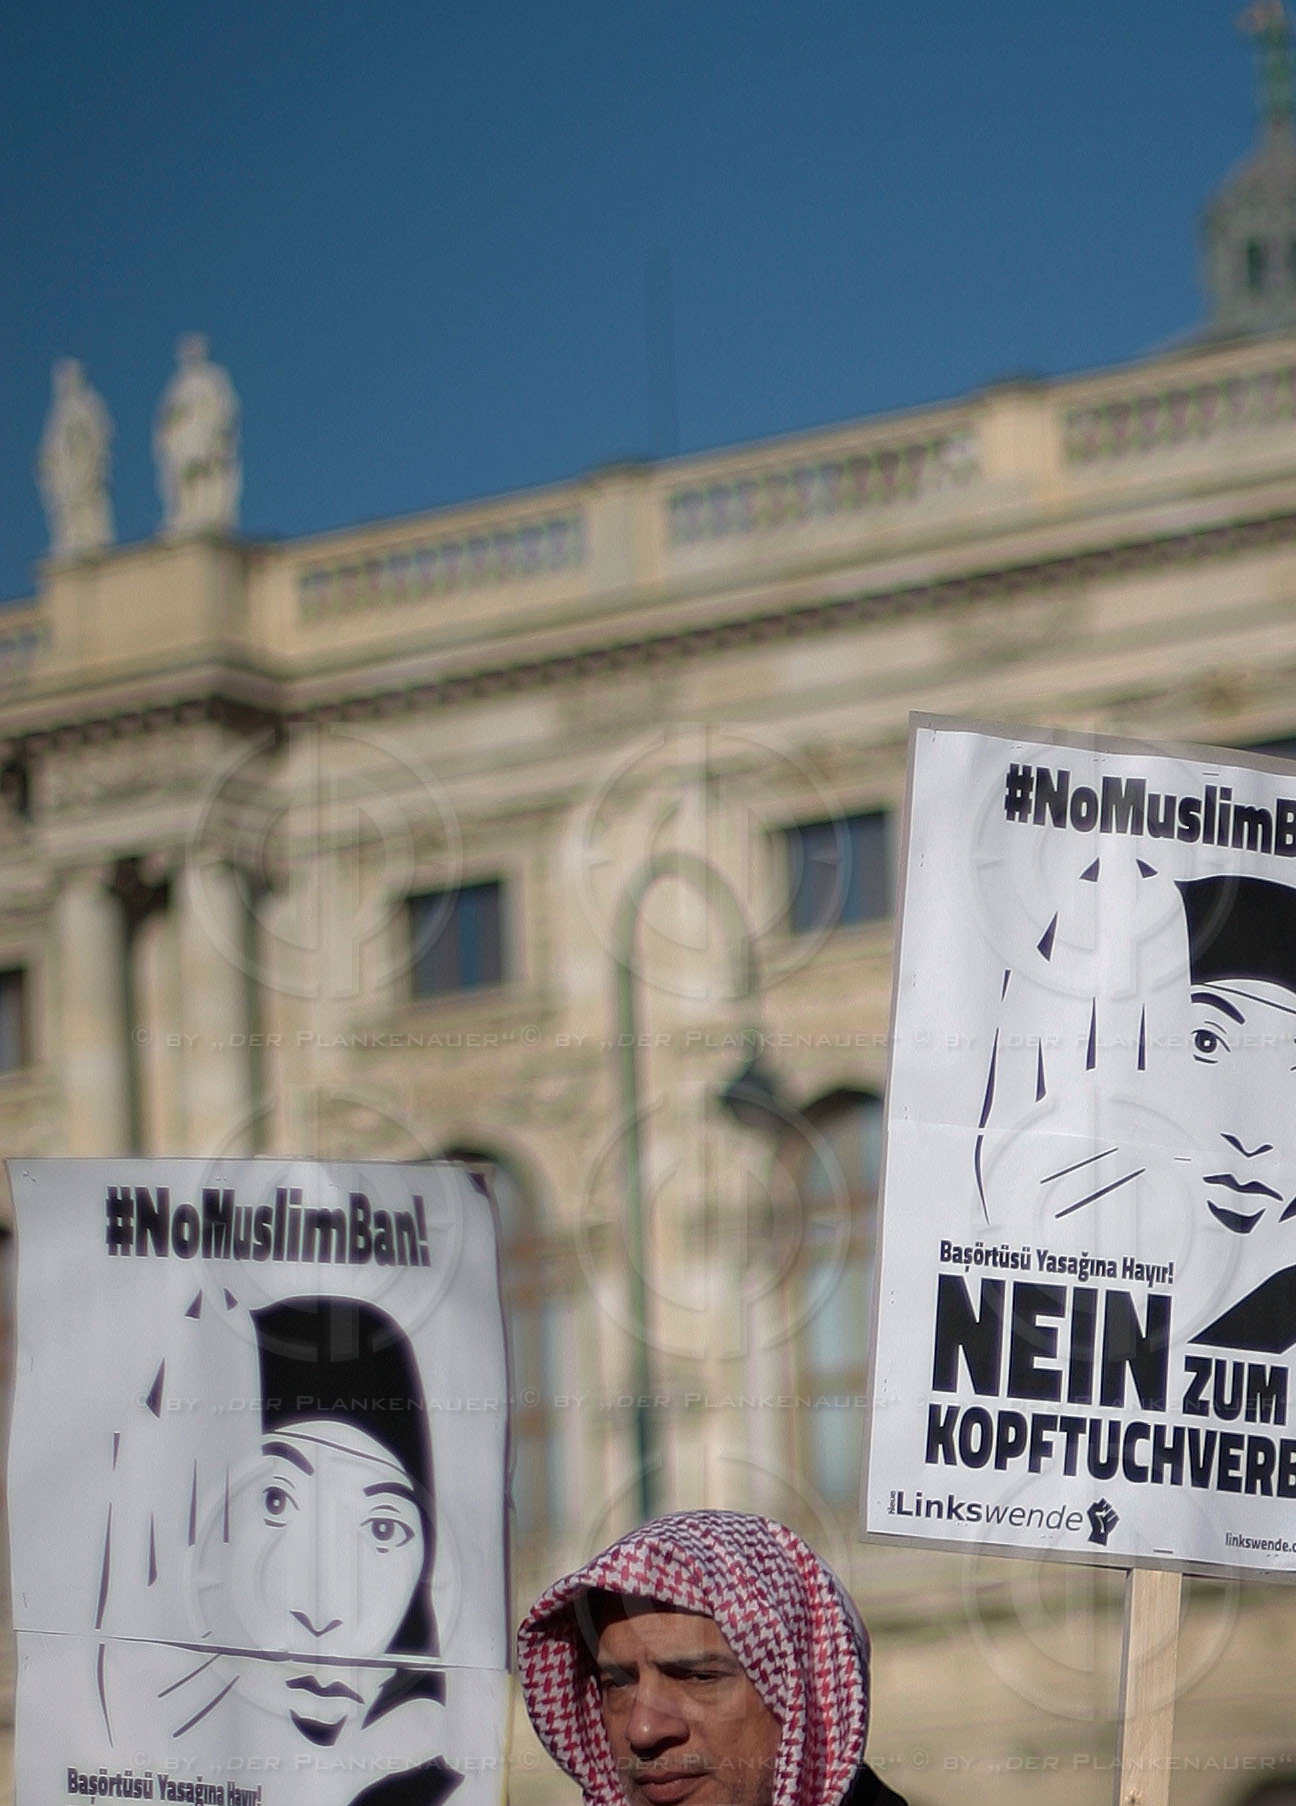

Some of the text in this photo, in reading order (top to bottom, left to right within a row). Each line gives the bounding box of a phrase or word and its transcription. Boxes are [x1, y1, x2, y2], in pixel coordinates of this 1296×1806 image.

[105, 1185, 431, 1267] #NoMuslimBan!
[940, 1240, 1174, 1288] Başörtüsü Yasağına Hayır!
[932, 1273, 1172, 1411] NEIN
[1182, 1355, 1289, 1426] ZUM
[897, 1491, 1083, 1531] Linkswende
[67, 1767, 153, 1805] Başörtüsü
